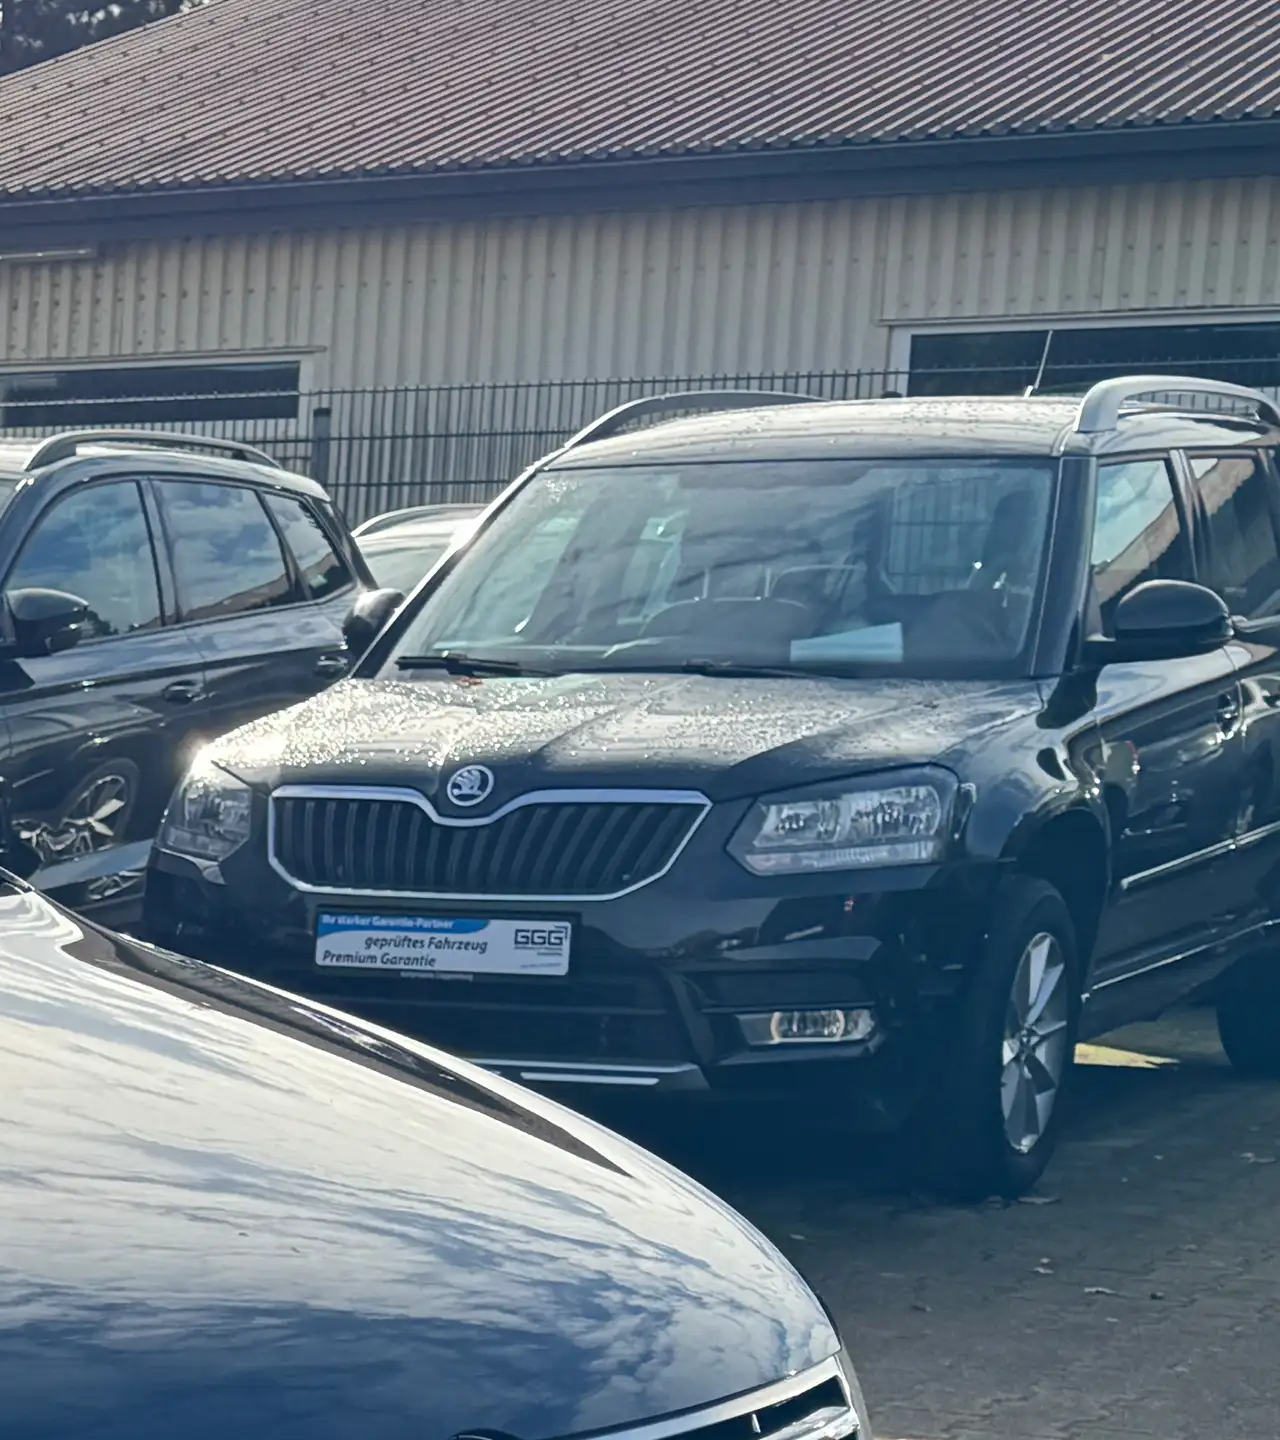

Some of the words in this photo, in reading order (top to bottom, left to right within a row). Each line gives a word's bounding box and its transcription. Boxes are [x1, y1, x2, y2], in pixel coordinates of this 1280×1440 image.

[364, 934, 425, 951] geprüftes
[427, 937, 488, 954] Fahrzeug
[514, 929, 563, 946] GGG
[323, 950, 378, 964] Premium
[380, 953, 436, 967] Garantie
